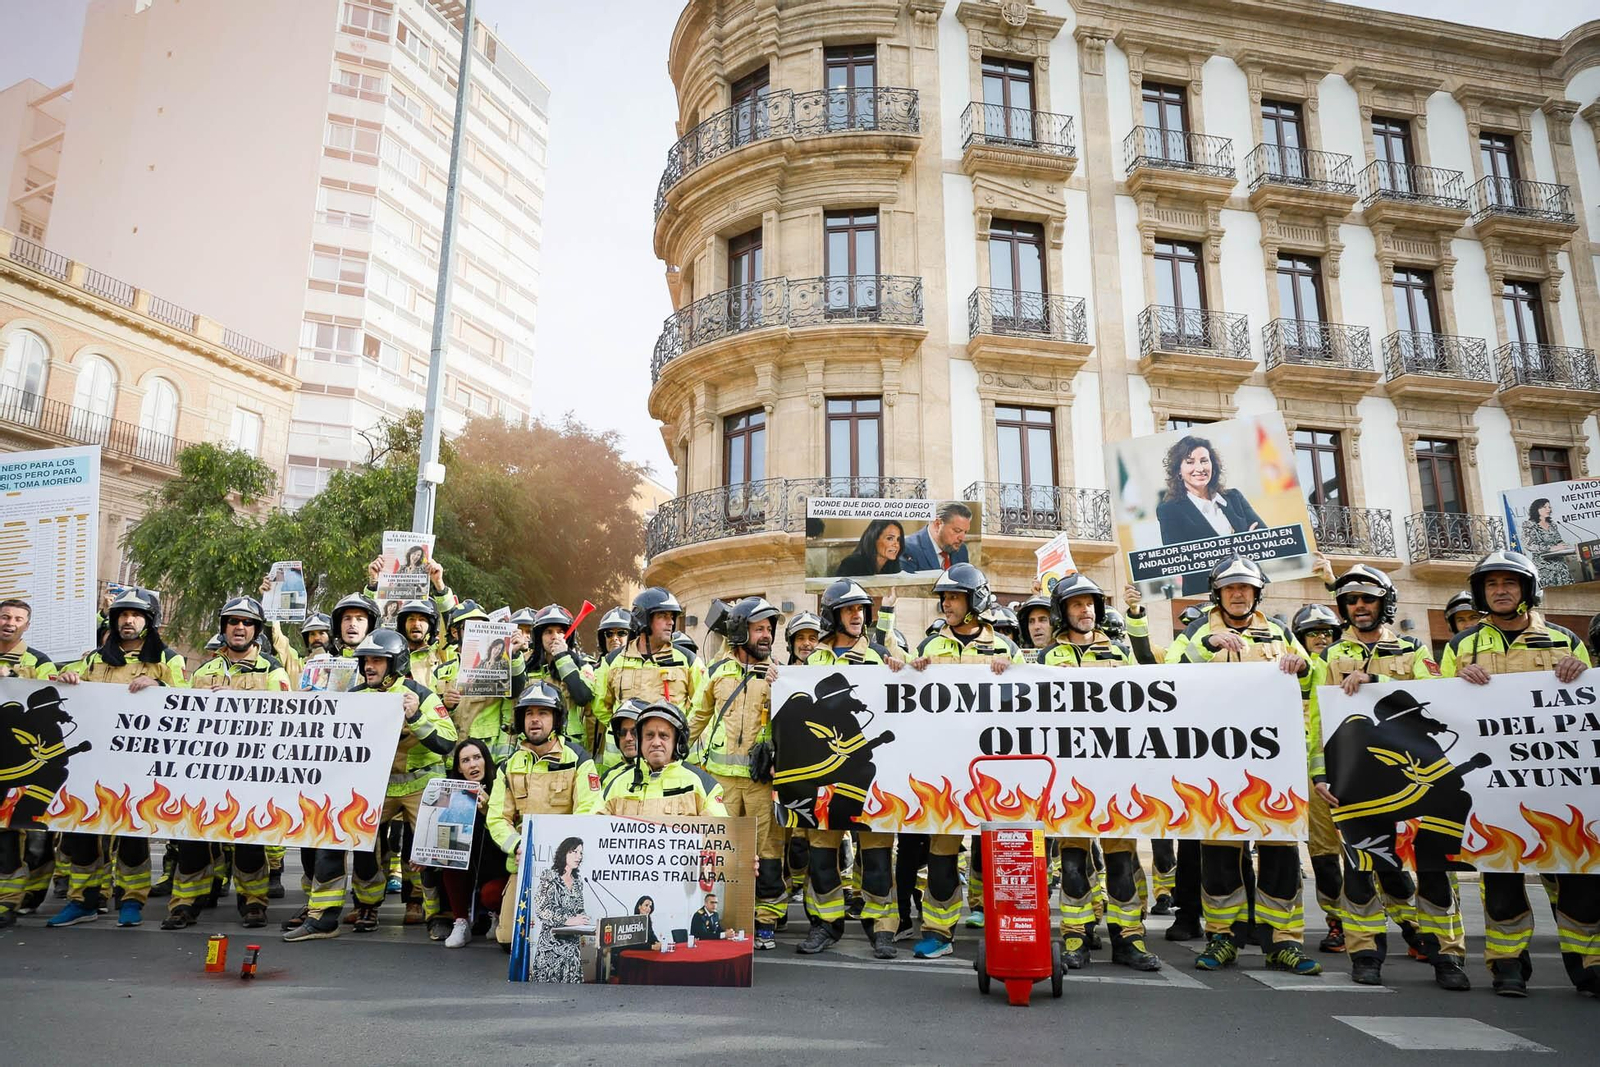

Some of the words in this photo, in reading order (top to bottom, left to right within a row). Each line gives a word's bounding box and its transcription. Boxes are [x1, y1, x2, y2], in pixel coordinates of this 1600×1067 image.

[25, 470, 50, 478] PERO
[53, 468, 77, 476] PARA
[30, 461, 54, 470] PARA
[14, 480, 40, 488] TOMA
[42, 476, 82, 486] MORENO
[813, 508, 836, 516] MARÍA
[842, 500, 859, 508] DIJE
[1138, 555, 1192, 570] ANDALUCÍA,
[1193, 548, 1232, 560] PORQUE
[1232, 545, 1246, 553] YO
[1247, 542, 1260, 551] LO
[1262, 537, 1297, 549] VALGO,
[1148, 546, 1179, 559] MEJOR
[1181, 540, 1216, 553] SUELDO
[1218, 538, 1232, 546] DE
[1233, 530, 1278, 544] ALCALDÍA
[1280, 528, 1293, 537] EN
[1162, 566, 1186, 575] PERO
[1188, 562, 1206, 571] LOS
[1262, 550, 1276, 558] NO
[164, 694, 207, 712] SIN
[214, 695, 338, 716] INVERSIÓN
[884, 680, 1178, 713] BOMBEROS
[1530, 686, 1596, 708] LAS
[115, 713, 150, 730] NO
[157, 716, 190, 733] SE
[196, 719, 274, 737] PUEDE
[279, 721, 325, 738] DAR
[331, 722, 364, 740] UN
[1476, 716, 1544, 737] DEL
[110, 735, 230, 758] SERVICIO
[236, 742, 265, 760] DE
[272, 744, 371, 764] CALIDAD
[979, 726, 1281, 760] QUEMADOS
[1509, 740, 1579, 761] SON
[146, 760, 178, 778] AL
[185, 762, 322, 785] CIUDADANO
[610, 822, 656, 834] VAMOS
[659, 823, 668, 834] A
[672, 823, 726, 835] CONTAR
[599, 838, 666, 850] MENTIRAS
[669, 839, 735, 853] TRALARA,
[608, 854, 654, 866] VAMOS
[657, 855, 666, 866] A
[670, 854, 725, 866] CONTAR
[592, 870, 659, 882] MENTIRAS
[618, 921, 645, 934] ALMERÍA
